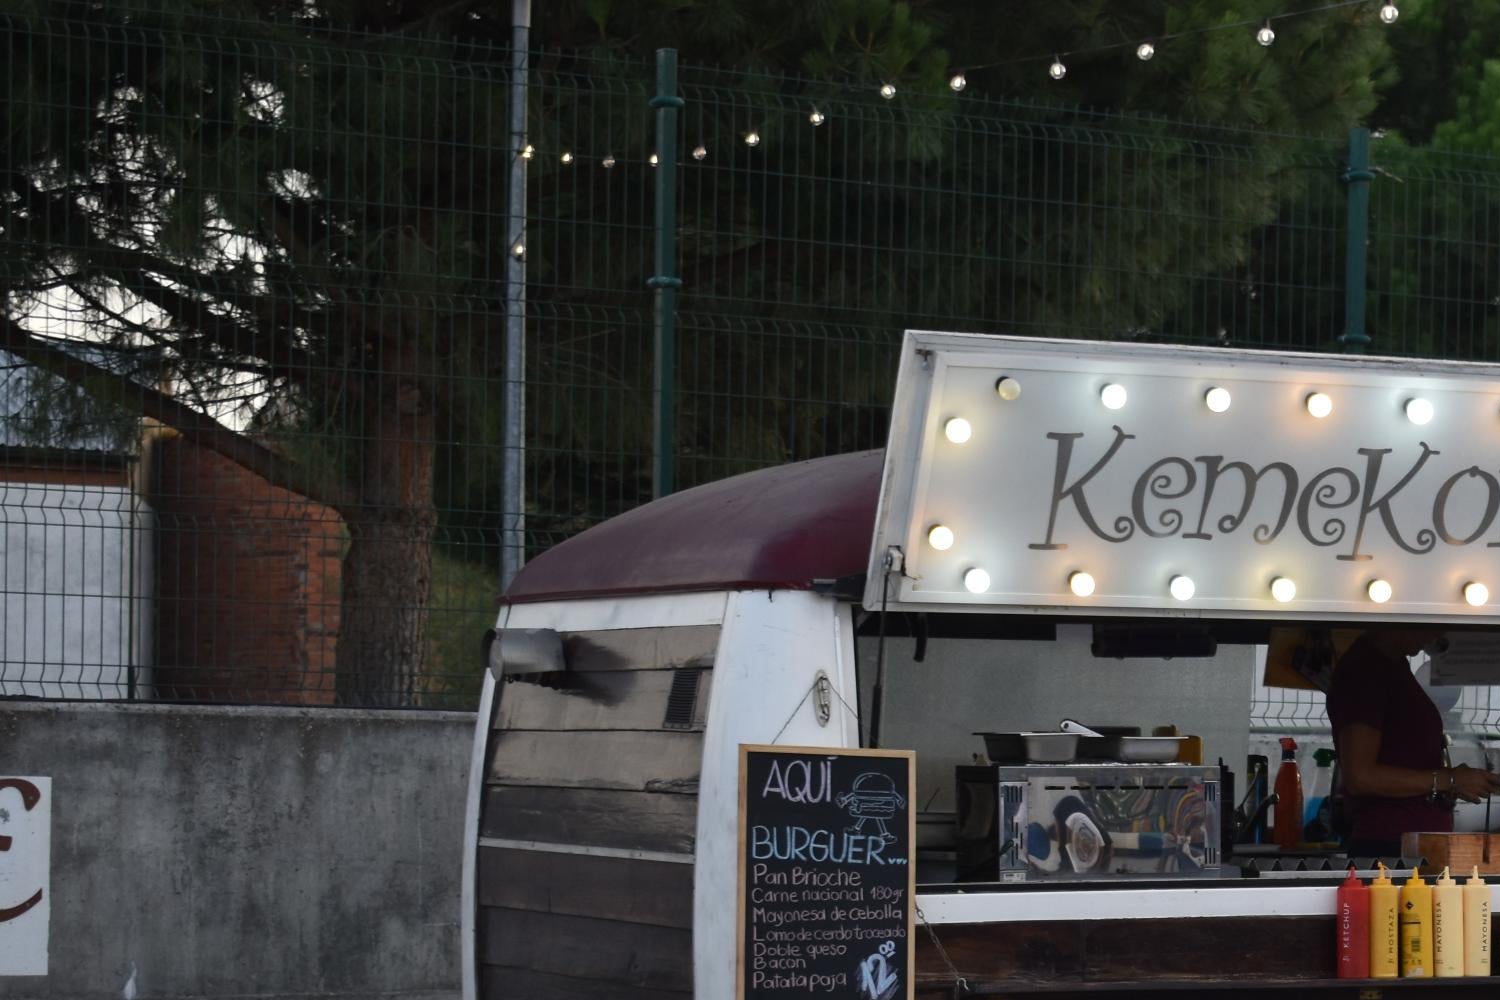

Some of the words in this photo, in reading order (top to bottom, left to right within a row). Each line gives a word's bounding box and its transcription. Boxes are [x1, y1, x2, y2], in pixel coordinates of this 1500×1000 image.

[753, 863, 787, 885] Pan
[792, 866, 861, 886] Brioche
[751, 887, 799, 903] Carne
[802, 888, 864, 901] nacional
[753, 907, 826, 926] Mayonesa
[831, 906, 847, 921] de
[797, 927, 812, 940] de
[814, 926, 852, 941] cerdo
[854, 924, 906, 940] troceado
[753, 943, 802, 957] Doble
[806, 944, 847, 959] queso
[753, 957, 806, 969] Bacon
[753, 971, 807, 989] Patata
[809, 973, 847, 992] paja
